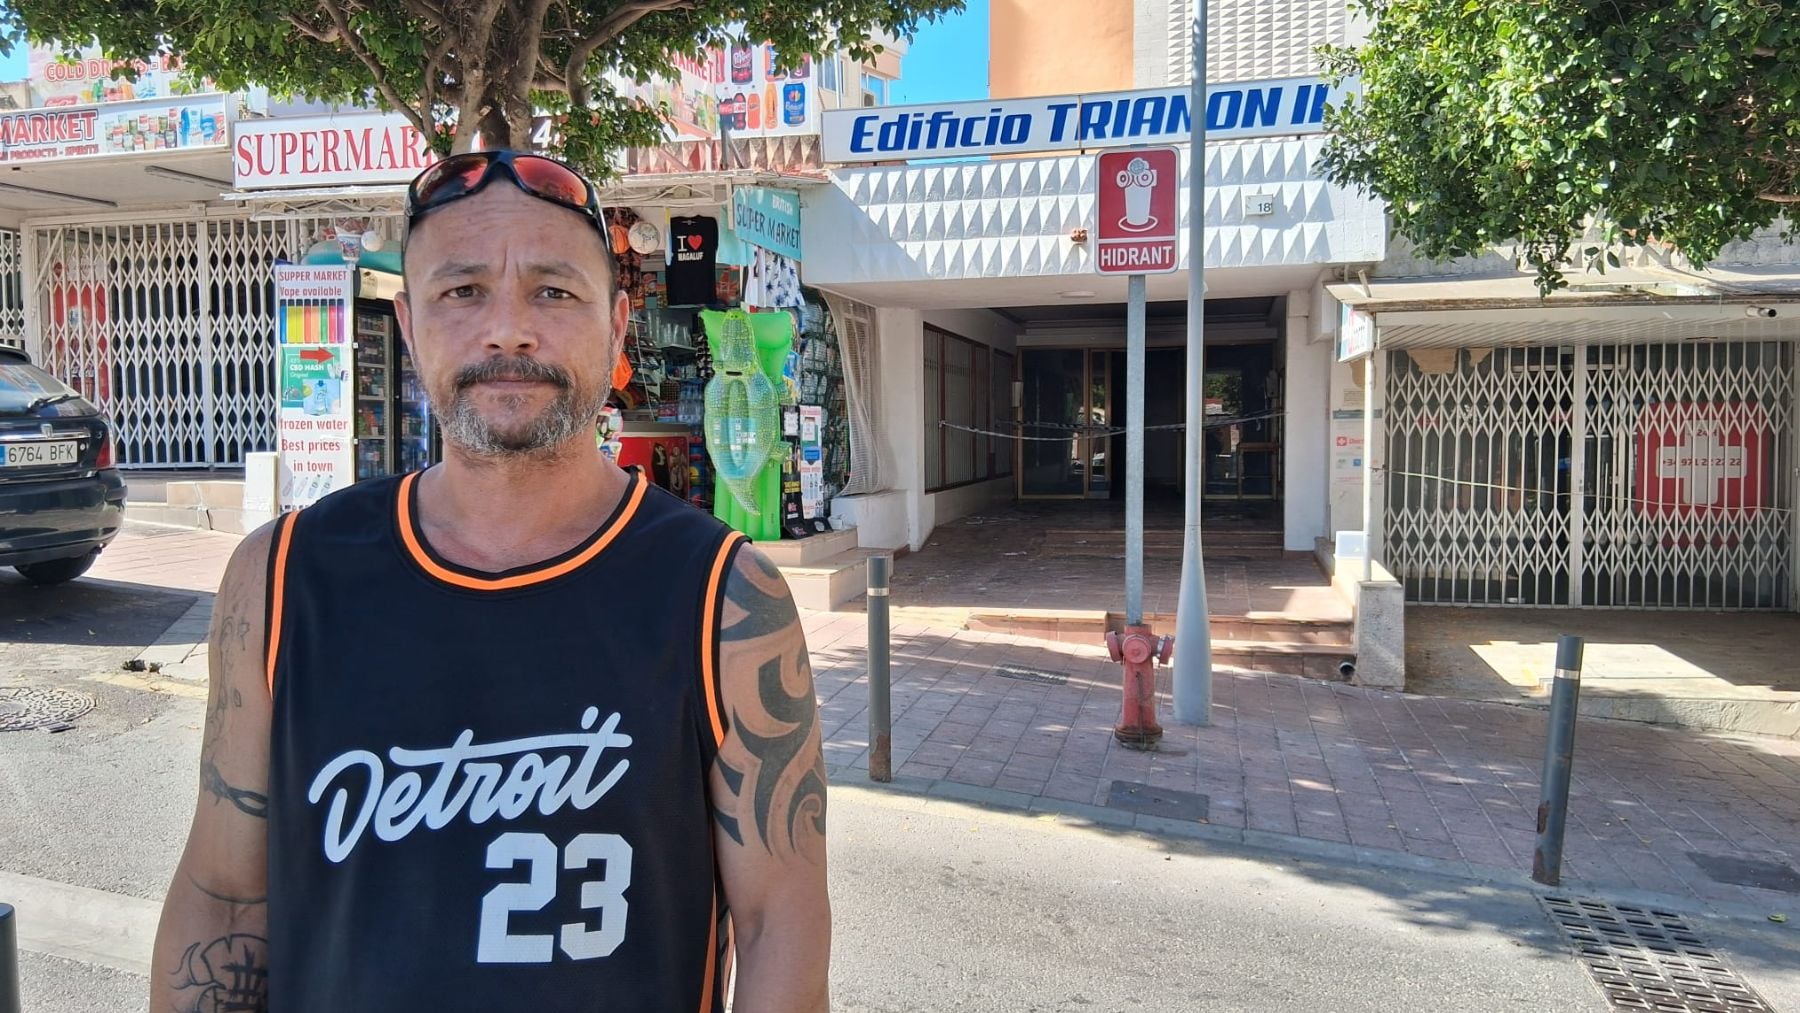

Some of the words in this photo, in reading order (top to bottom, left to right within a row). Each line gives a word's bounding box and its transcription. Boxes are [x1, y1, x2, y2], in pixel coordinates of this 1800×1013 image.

[45, 60, 85, 81] COLD
[88, 57, 149, 80] DRS
[850, 108, 1032, 153] Edificio
[1047, 88, 1283, 142] TRIANON
[1258, 203, 1271, 212] 18
[767, 217, 800, 249] MARKET
[677, 236, 687, 252] I
[1101, 246, 1172, 266] HIDRANT
[280, 271, 310, 281] SUPPER
[314, 271, 347, 281] MARKET
[280, 287, 300, 298] Vape
[303, 287, 342, 296] available
[317, 419, 347, 429] water
[9, 446, 42, 463] 6764
[50, 444, 73, 460] BFK
[282, 439, 304, 451] Best
[309, 440, 340, 454] prices
[294, 460, 303, 471] in
[307, 461, 333, 471] town
[308, 706, 633, 863] Detroit
[477, 832, 633, 963] 23
